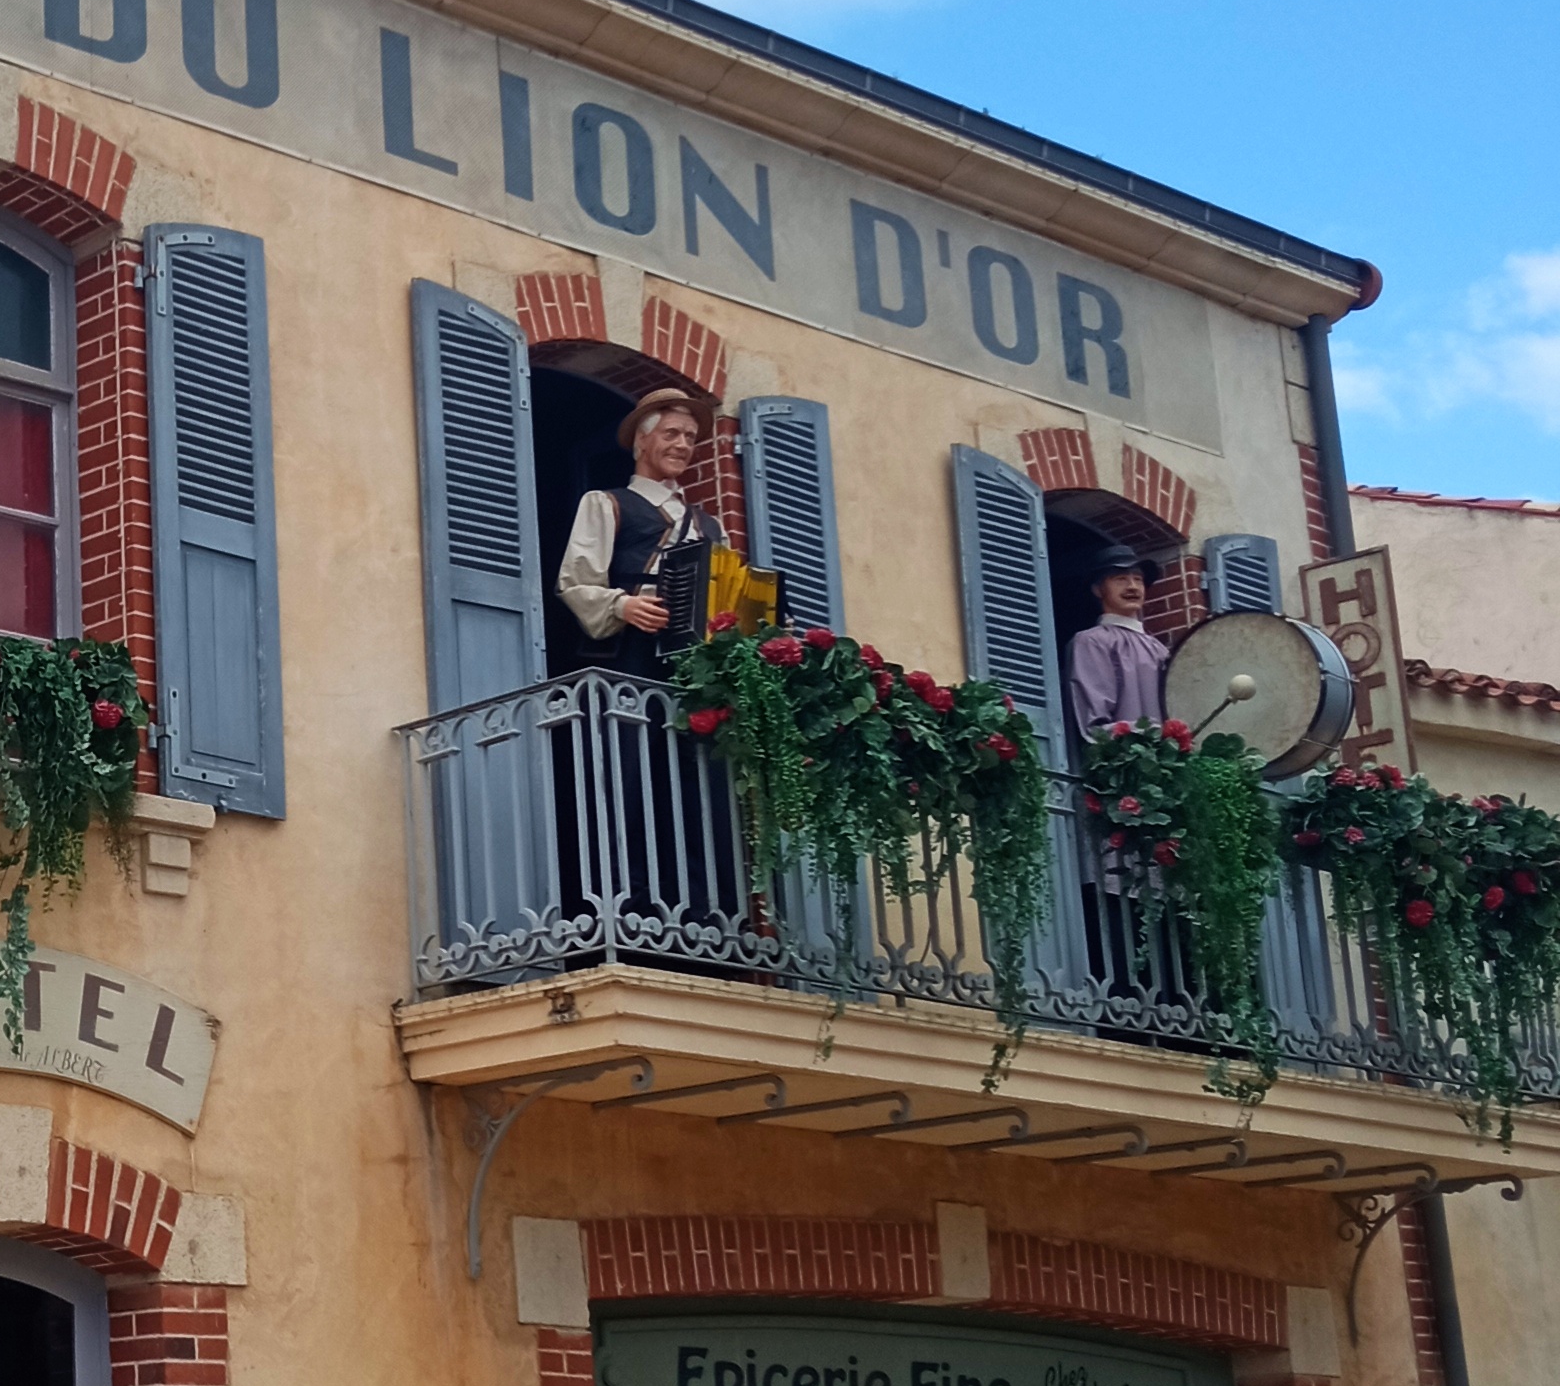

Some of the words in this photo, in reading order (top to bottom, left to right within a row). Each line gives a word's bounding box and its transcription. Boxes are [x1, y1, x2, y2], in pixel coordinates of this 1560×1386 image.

[379, 28, 777, 282] LION
[849, 198, 1132, 399] D'OR
[1319, 568, 1394, 771] HOTE
